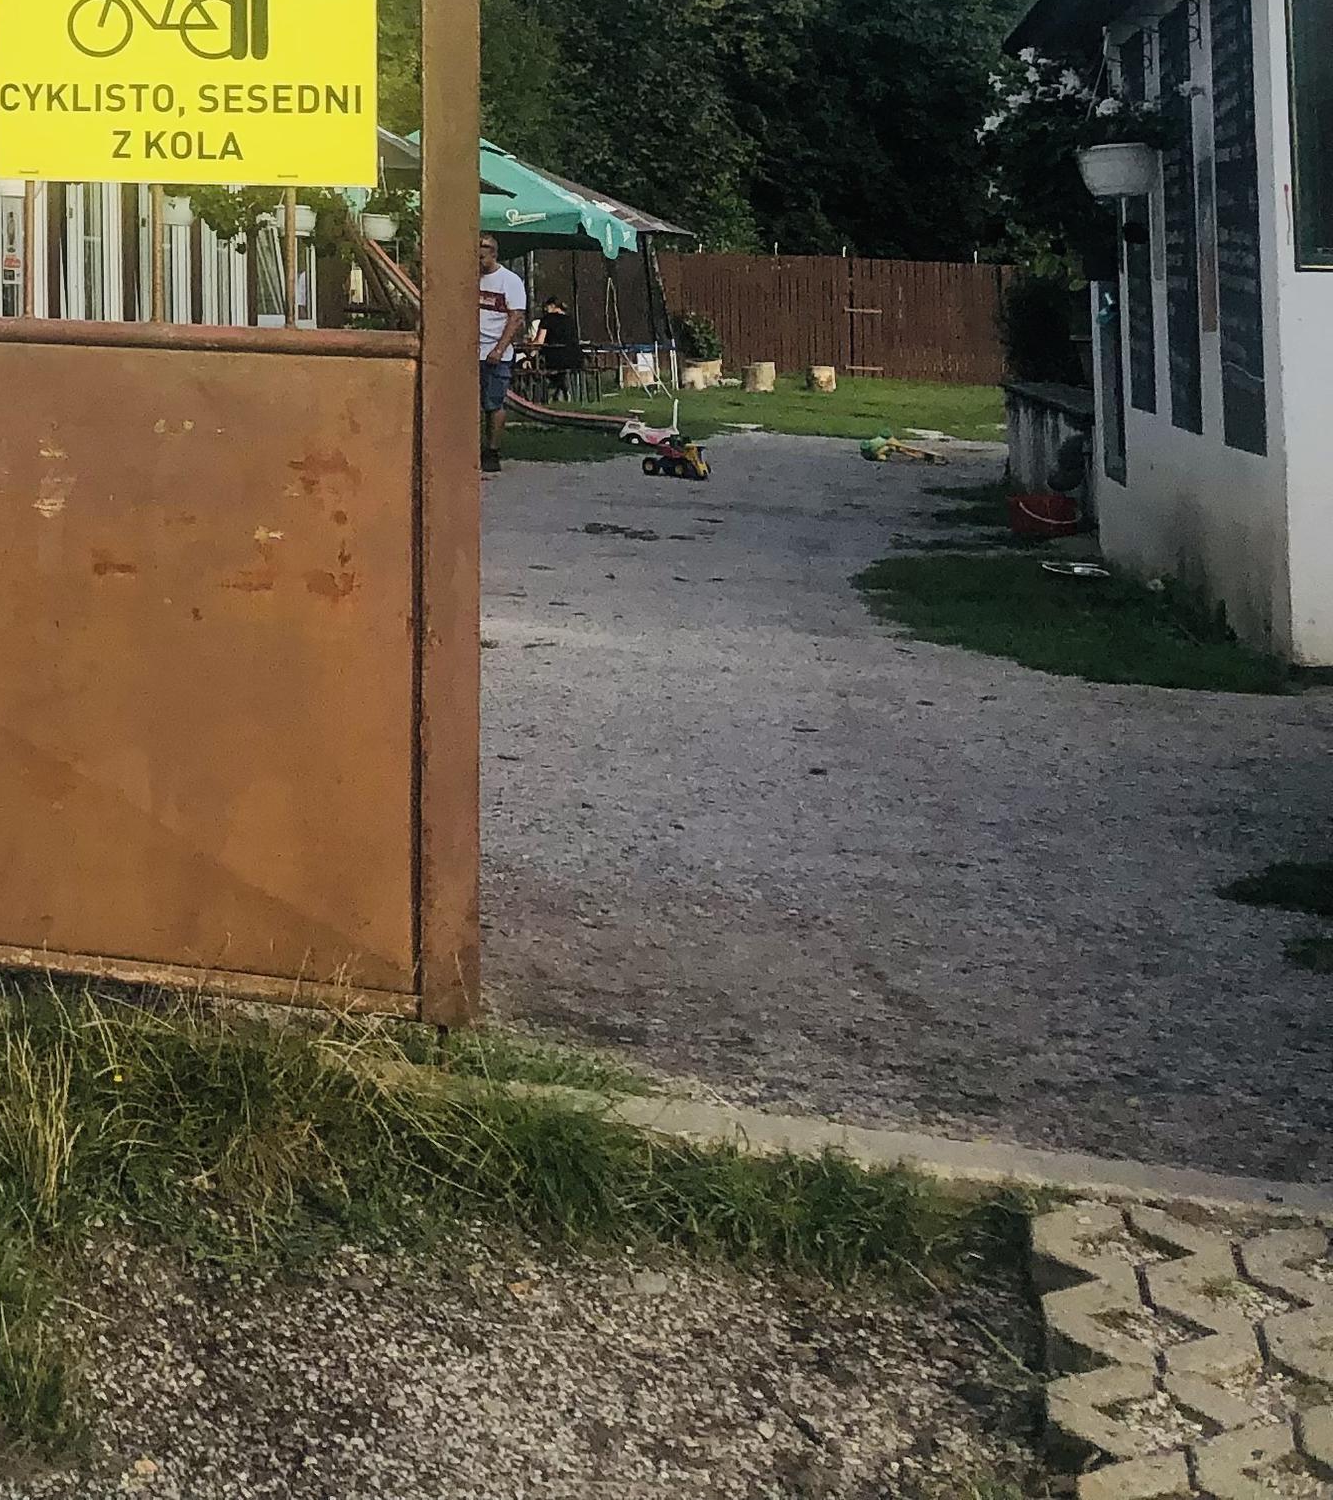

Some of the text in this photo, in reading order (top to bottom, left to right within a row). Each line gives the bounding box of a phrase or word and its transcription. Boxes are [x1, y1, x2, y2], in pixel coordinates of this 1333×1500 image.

[0, 82, 363, 118] CYKLISTO, SESEDNI
[111, 131, 244, 161] Z KOLA
